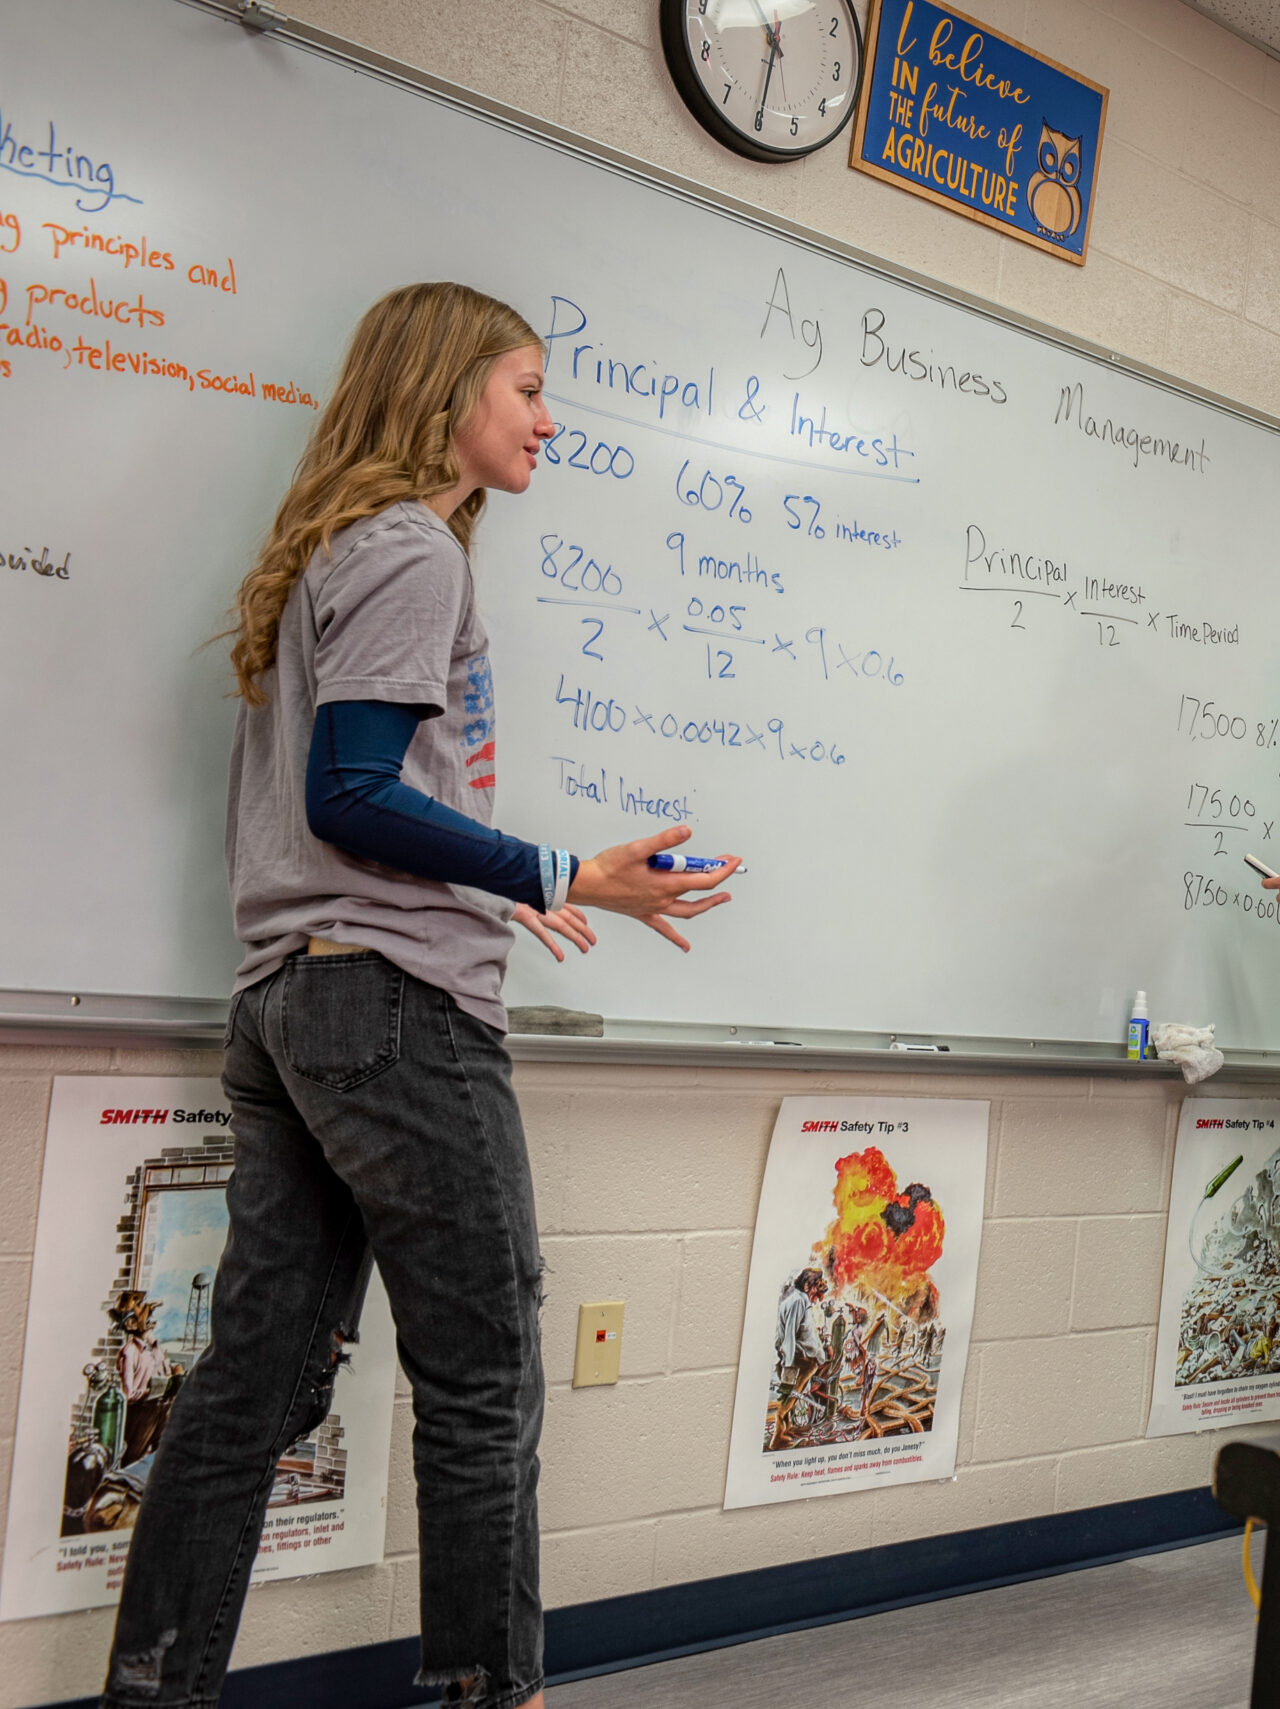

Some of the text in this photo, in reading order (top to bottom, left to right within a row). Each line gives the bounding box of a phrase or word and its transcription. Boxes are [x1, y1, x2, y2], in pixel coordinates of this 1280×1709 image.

[829, 17, 838, 38] 2
[701, 40, 711, 61] 8
[897, 1, 1030, 104] I believe
[832, 62, 841, 81] 3
[891, 57, 919, 95] IN
[723, 83, 732, 104] 7
[818, 98, 826, 117] 4
[754, 110, 764, 131] 6
[789, 115, 799, 136] 5
[889, 82, 1022, 177] THE future of
[881, 126, 1019, 216] AGRICULTURE
[42, 222, 175, 270] principles
[188, 257, 236, 294] and
[26, 277, 165, 327] products
[544, 295, 915, 468] Principal & Interest
[760, 267, 1211, 474] Ag Business Management
[543, 422, 902, 550] 8200 60% 5% interest
[540, 534, 623, 596] 8200
[666, 532, 784, 594] 9 months
[965, 524, 1068, 586] Principal
[1085, 576, 1146, 604] Interest
[1010, 601, 1026, 630] 2
[1098, 623, 1121, 647] 12
[581, 618, 605, 662] 2
[706, 643, 737, 680] 12
[805, 626, 828, 681] 9
[555, 673, 626, 732] 4100
[1256, 719, 1279, 749] 8%
[549, 756, 608, 803] Total
[1213, 831, 1228, 856] 2
[1184, 871, 1228, 910] 8750
[100, 1109, 232, 1126] SMITH Safety
[801, 1120, 909, 1134] SMITH Safety Tip #3
[1196, 1119, 1224, 1129] SMITH
[1225, 1119, 1250, 1131] Safety
[1252, 1119, 1265, 1130] Tip
[770, 1474, 786, 1483] Safety
[801, 1470, 813, 1478] Keep
[869, 1461, 881, 1469] away
[882, 1459, 892, 1467] from
[276, 1516, 294, 1527] their
[313, 1524, 329, 1534] inlet
[331, 1522, 345, 1532] and
[276, 1537, 332, 1551] fittings or other
[56, 1559, 82, 1572] Safety
